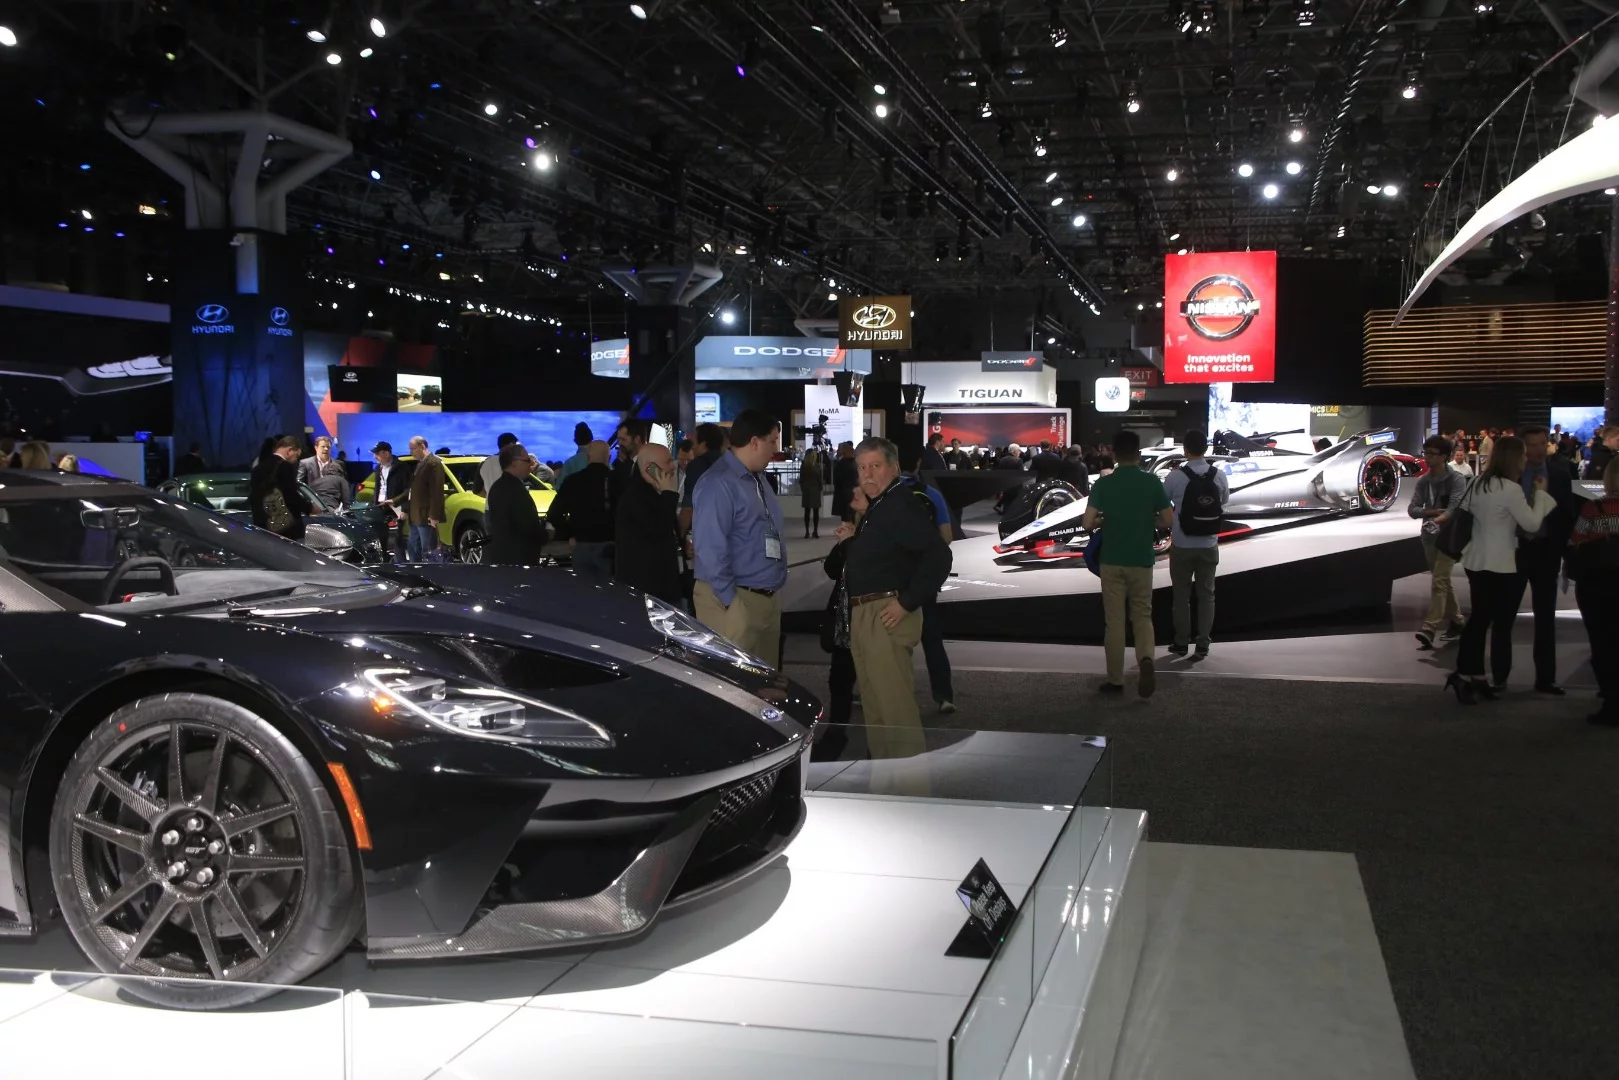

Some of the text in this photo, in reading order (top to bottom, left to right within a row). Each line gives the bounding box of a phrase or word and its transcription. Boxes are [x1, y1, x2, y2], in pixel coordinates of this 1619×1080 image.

[1187, 301, 1252, 315] NISSAN
[192, 325, 234, 334] HYUNDAI
[847, 329, 903, 341] HYUNDAI
[733, 346, 837, 357] DODGE
[1187, 353, 1251, 363] Innovation
[1184, 363, 1255, 373] that excites
[1125, 370, 1152, 380] EXIT
[958, 388, 1023, 399] TIGUAN
[1058, 416, 1066, 448] Challenge
[1249, 450, 1274, 458] NISSAN
[1048, 527, 1075, 537] RICHARD
